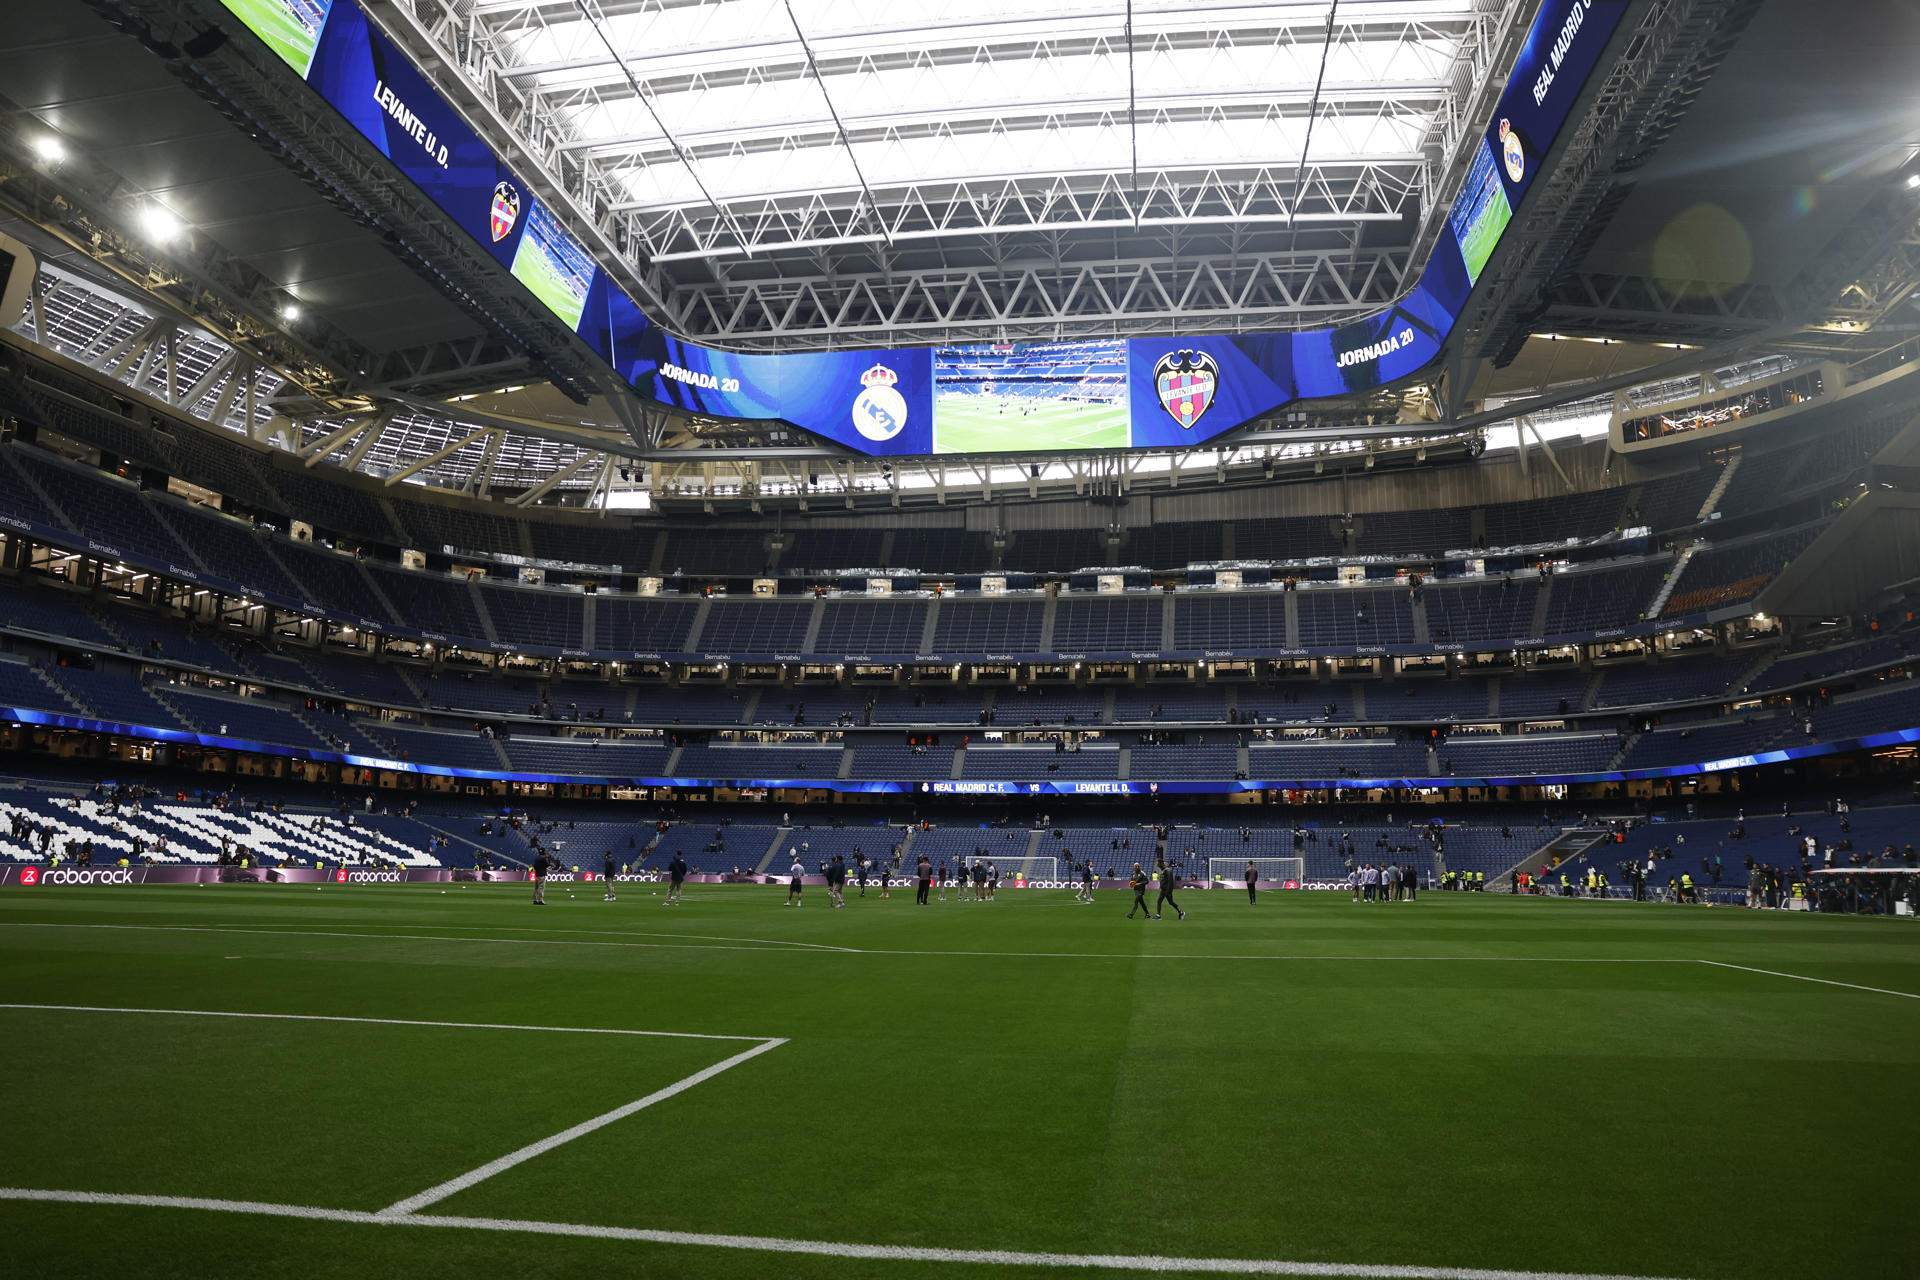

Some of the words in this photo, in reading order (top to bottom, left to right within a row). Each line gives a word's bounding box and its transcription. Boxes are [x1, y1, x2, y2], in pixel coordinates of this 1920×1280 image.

[1533, 63, 1555, 107] REAL
[1550, 1, 1584, 72] MADRID
[373, 79, 427, 145] LEVANTE
[425, 132, 437, 158] U.
[437, 145, 449, 170] D.
[1337, 336, 1400, 368] JORNADA
[1399, 327, 1415, 347] 20
[659, 362, 719, 390] JORNADA
[721, 377, 740, 393] 20
[0, 515, 32, 531] ernabéu
[934, 783, 953, 792] REAL
[956, 783, 987, 792] MADRID
[1030, 783, 1040, 792] VS
[1076, 784, 1111, 792] LEVANTE
[42, 867, 133, 885] roborock
[348, 869, 400, 882] roborock
